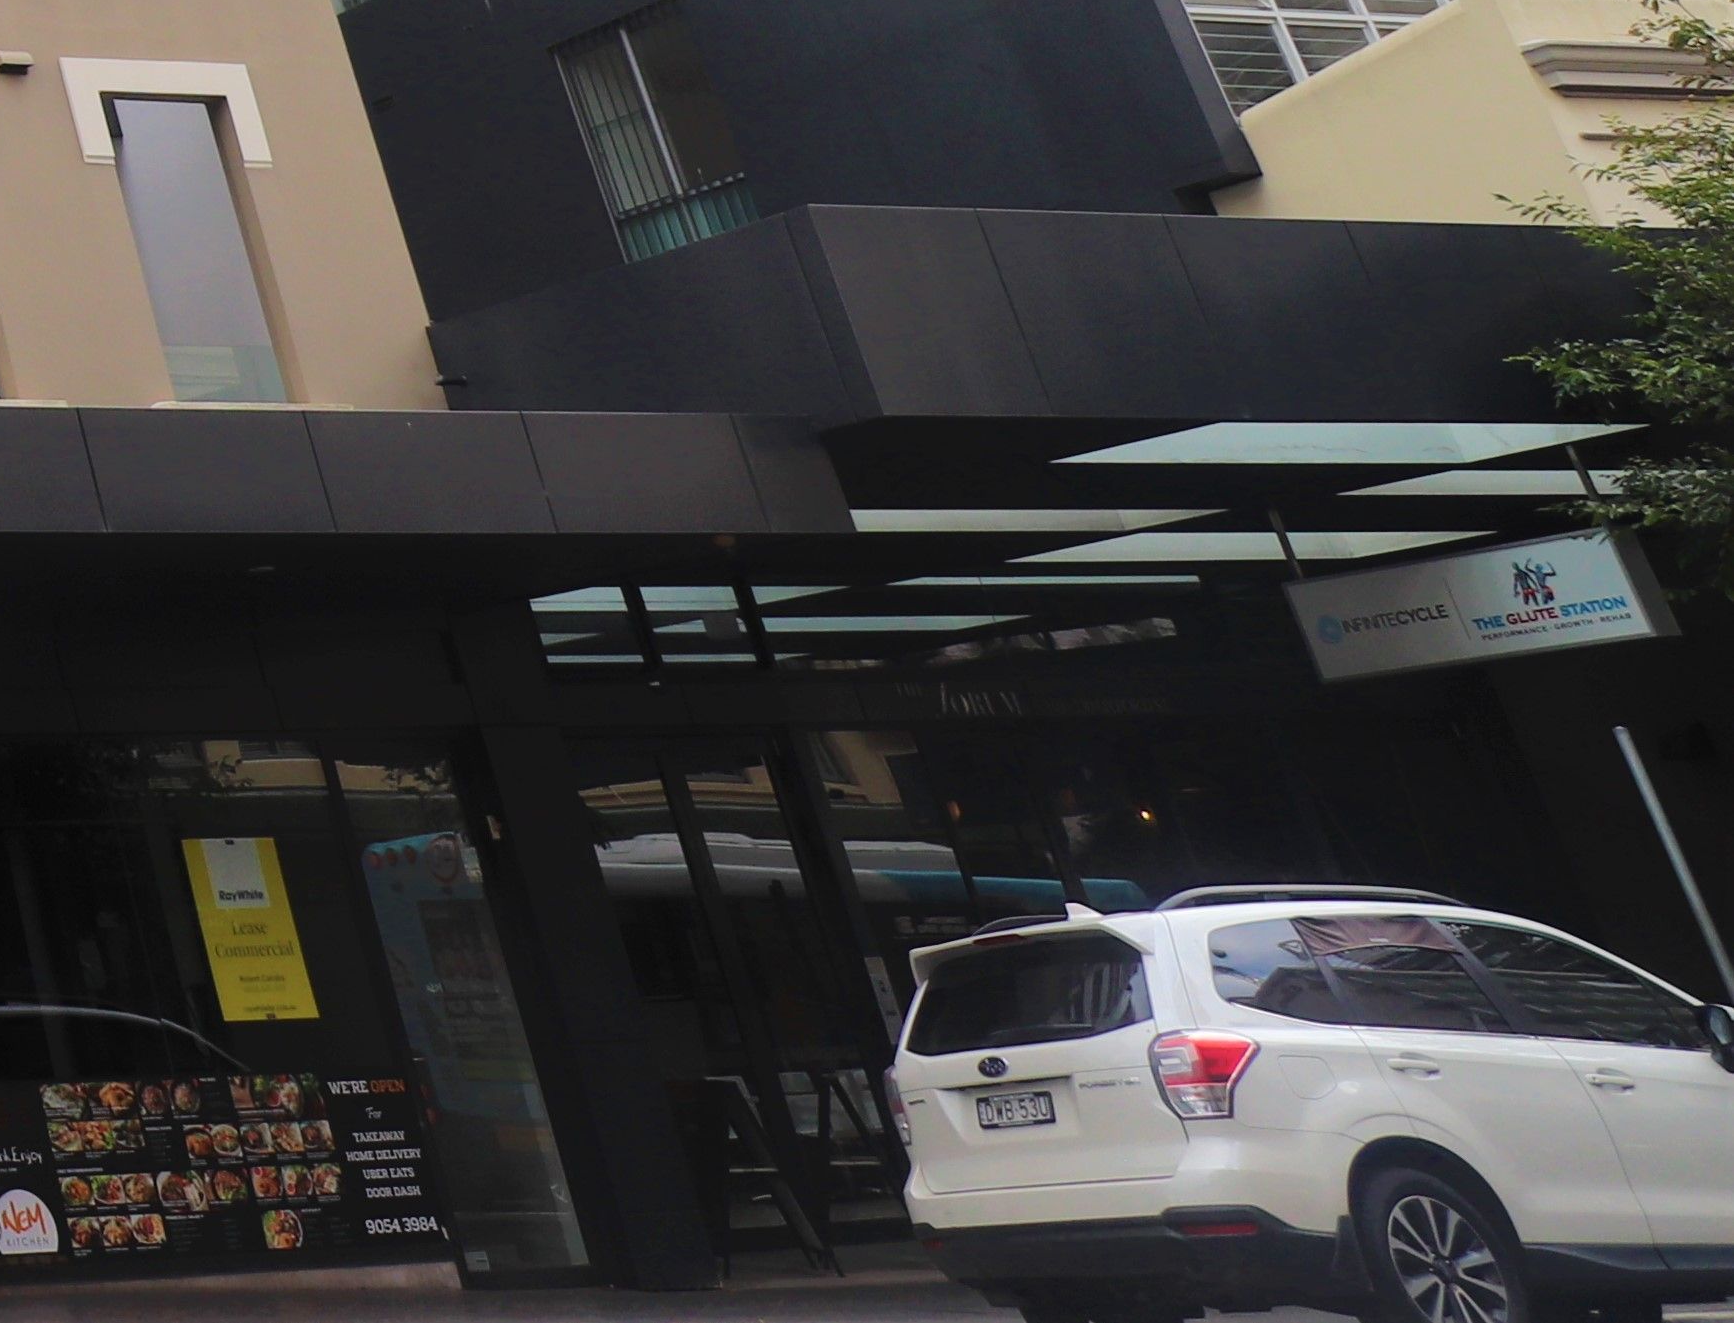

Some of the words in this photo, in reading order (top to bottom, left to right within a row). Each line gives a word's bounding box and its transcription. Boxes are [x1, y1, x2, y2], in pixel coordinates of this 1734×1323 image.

[1472, 615, 1505, 631] THE
[1507, 606, 1559, 626] GLUTE
[1561, 595, 1628, 617] STATION
[1482, 625, 1548, 641] PERFORMANCE
[1554, 618, 1594, 632] GROWTH
[1600, 612, 1632, 624] REHAB
[232, 922, 268, 936] Lease
[214, 940, 296, 958] Commercial
[370, 1078, 406, 1094] OPEN
[352, 1130, 406, 1143] TAKEAWAY
[345, 1149, 376, 1162] HOME
[376, 1148, 422, 1160] DELIVERY
[362, 1167, 390, 1180] UBER
[390, 1166, 416, 1179] EATS
[365, 1186, 394, 1199] DOOR
[394, 1185, 422, 1197] DASH
[364, 1218, 402, 1235] 9054
[402, 1216, 440, 1234] 3984
[6, 1236, 50, 1249] KITCHEN
